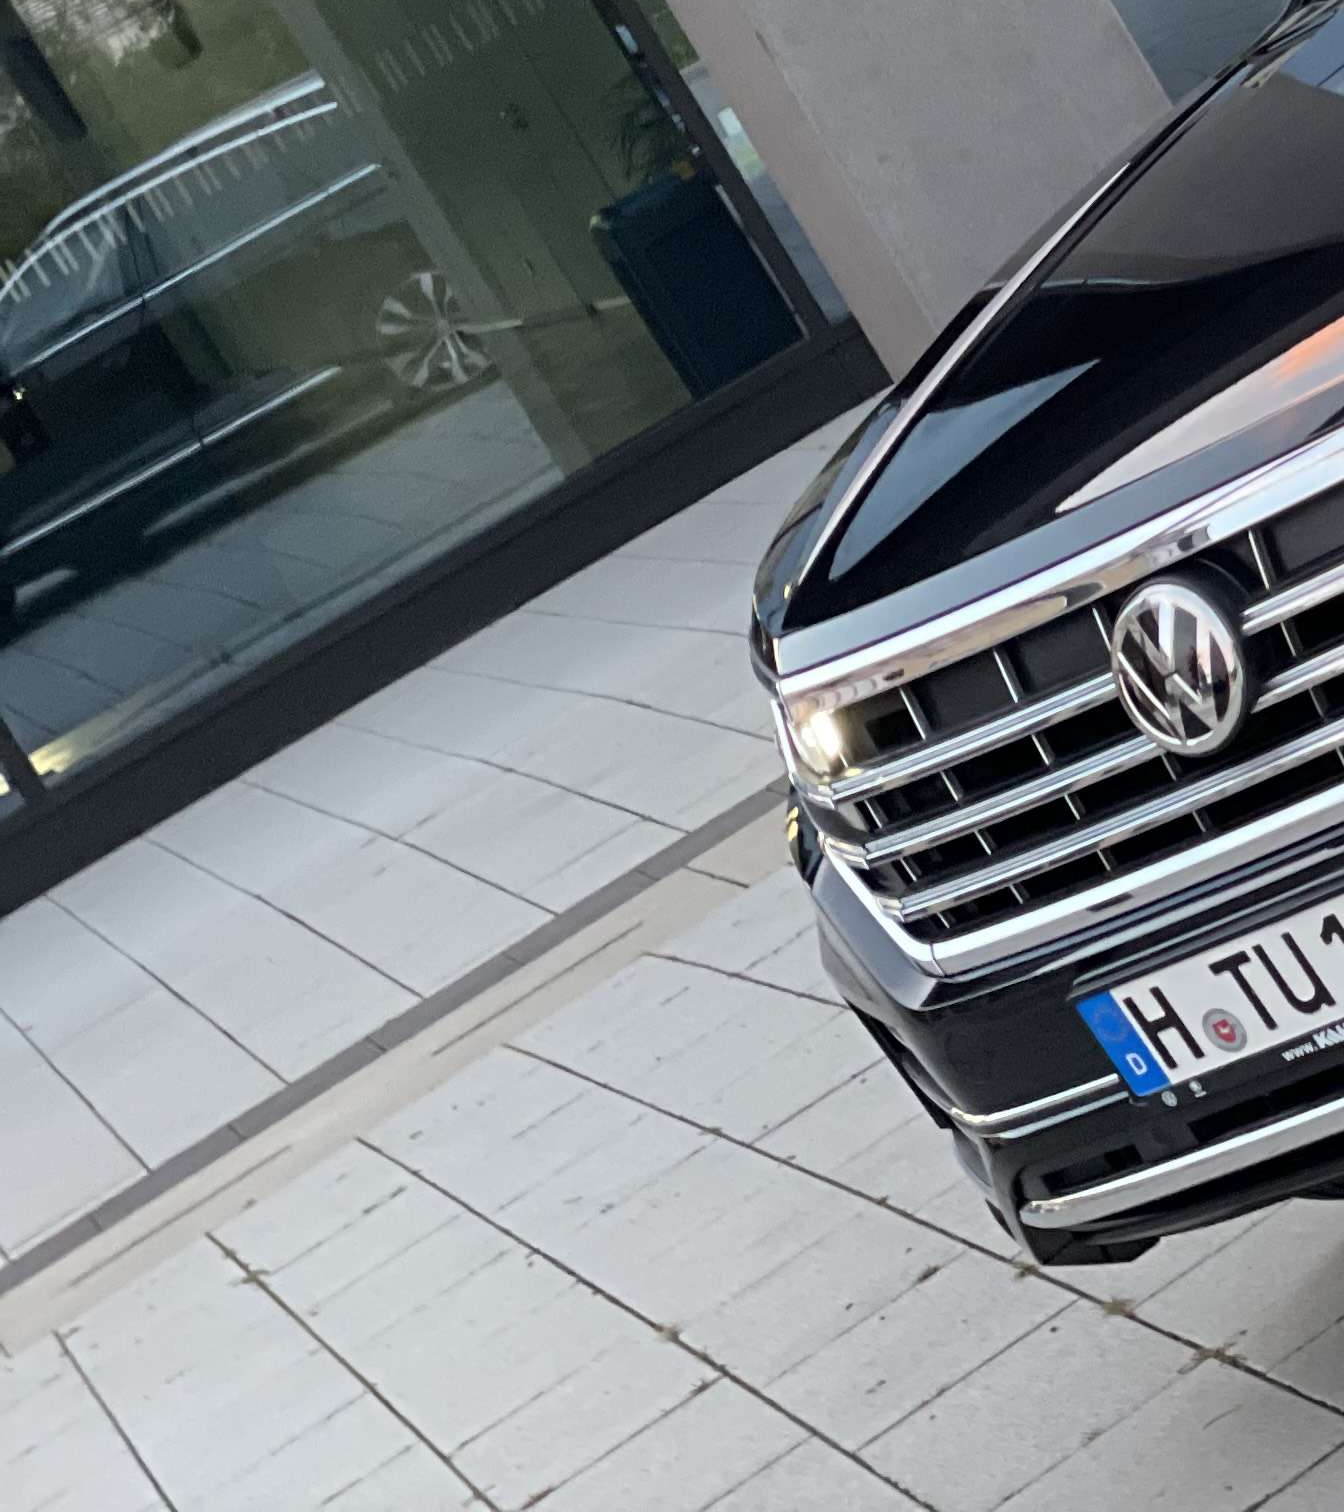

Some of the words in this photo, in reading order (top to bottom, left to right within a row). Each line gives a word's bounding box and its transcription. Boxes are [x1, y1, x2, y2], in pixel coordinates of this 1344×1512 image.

[1112, 584, 1243, 756] VW
[1123, 987, 1206, 1069] H
[1126, 1052, 1147, 1076] D
